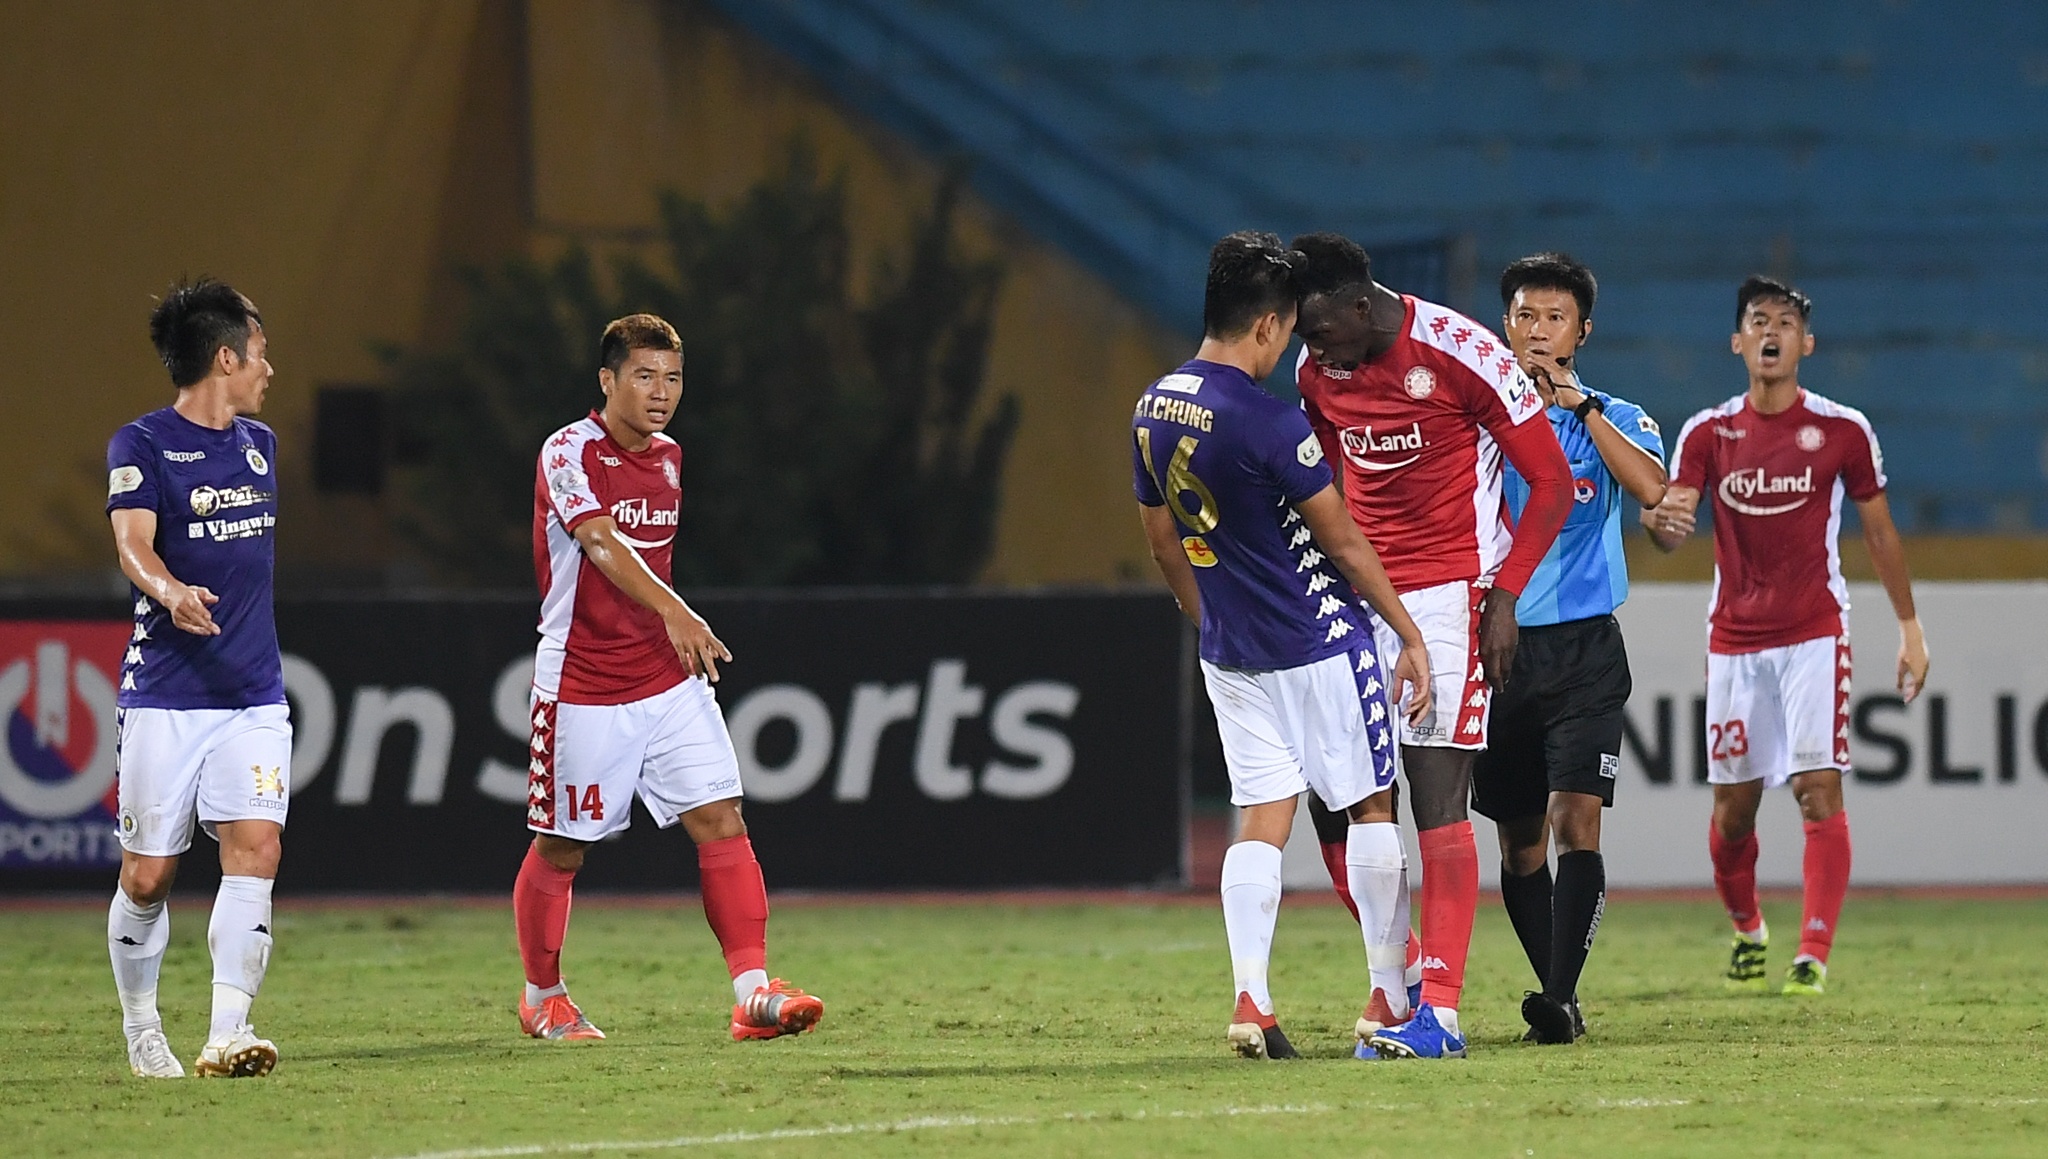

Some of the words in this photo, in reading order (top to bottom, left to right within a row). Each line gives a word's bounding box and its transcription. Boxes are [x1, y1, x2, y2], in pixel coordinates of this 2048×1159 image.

[1136, 426, 1219, 534] 16
[478, 654, 1081, 801] Sorts
[1710, 719, 1748, 760] 23
[250, 764, 284, 800] 14
[565, 783, 604, 821] 14
